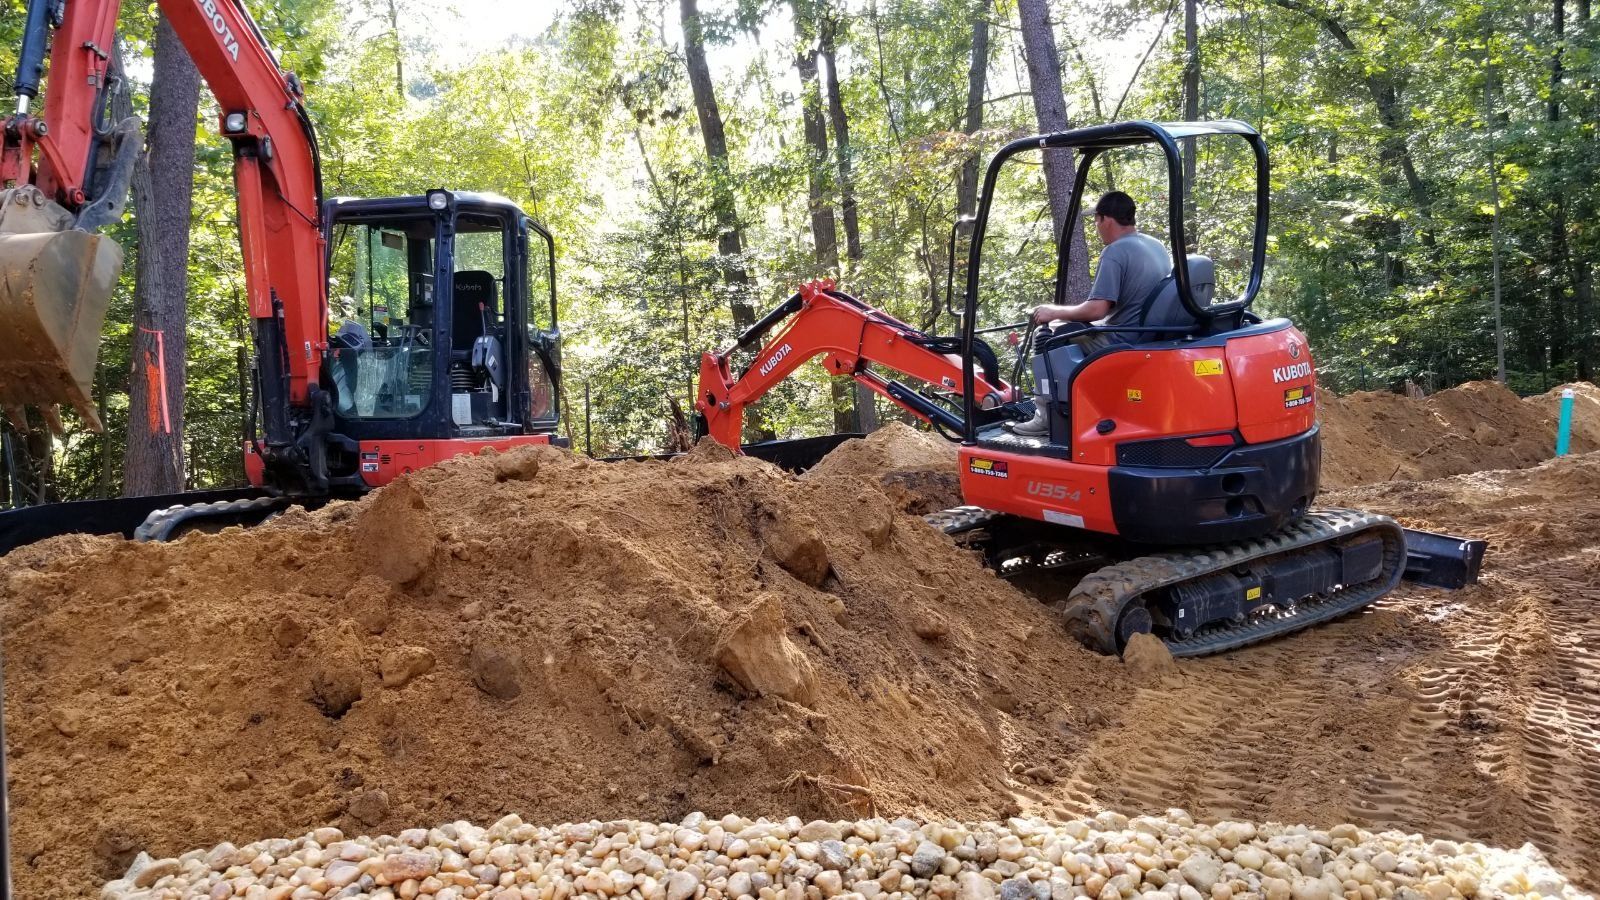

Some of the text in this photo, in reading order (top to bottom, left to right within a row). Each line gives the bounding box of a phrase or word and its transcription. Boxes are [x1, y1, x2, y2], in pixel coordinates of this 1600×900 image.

[199, 0, 239, 62] BOTA
[760, 343, 792, 377] KUBOTA
[1273, 361, 1311, 383] KUBOTA
[1027, 480, 1082, 502] U35-4
